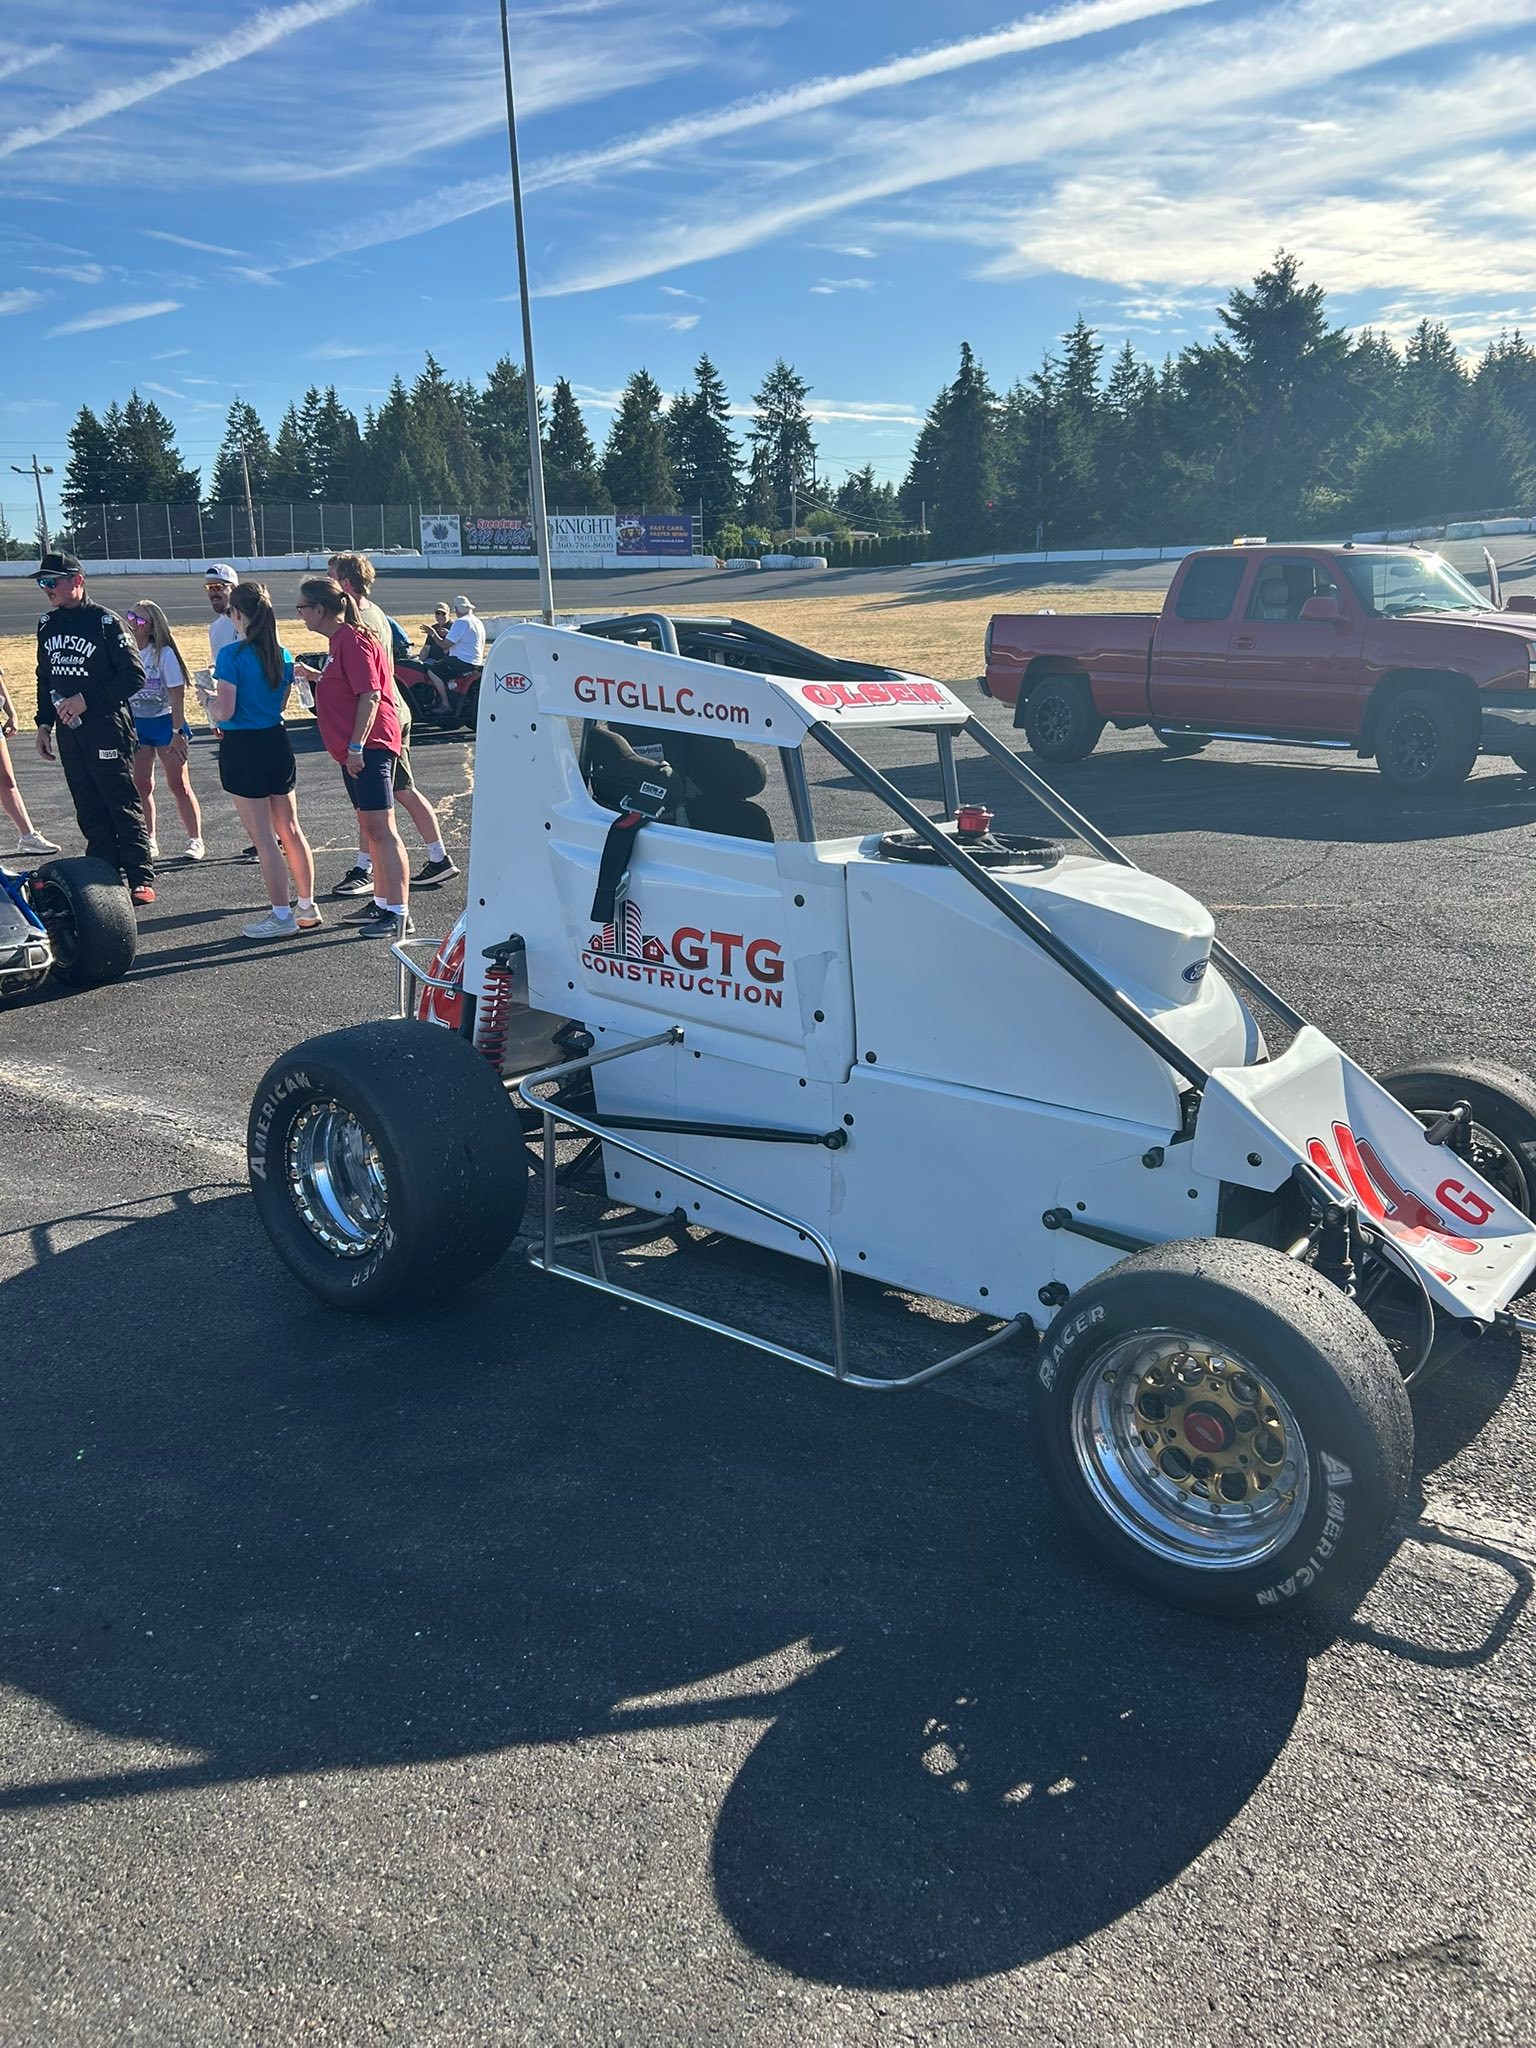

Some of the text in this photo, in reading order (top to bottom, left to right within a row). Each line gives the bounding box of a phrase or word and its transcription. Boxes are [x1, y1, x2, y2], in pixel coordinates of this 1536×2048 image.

[467, 528, 531, 545] CAR WASH
[477, 519, 522, 529] Speedway
[555, 518, 613, 534] KNIGHT
[556, 541, 615, 550] 360-786-8606
[573, 534, 615, 542] PROTECTION
[44, 634, 97, 658] SIMPSON
[51, 651, 86, 665] Racing
[505, 676, 526, 687] RFC
[574, 675, 750, 725] GTGLLC.com
[801, 683, 952, 709] OLSEN
[671, 926, 785, 984] GTG
[581, 952, 783, 1008] CONSTRUCTION
[249, 1071, 311, 1181] AMERICAN
[1435, 1177, 1496, 1227] G
[1037, 1304, 1107, 1392] RACER
[1255, 1449, 1354, 1606] AMERICAN
